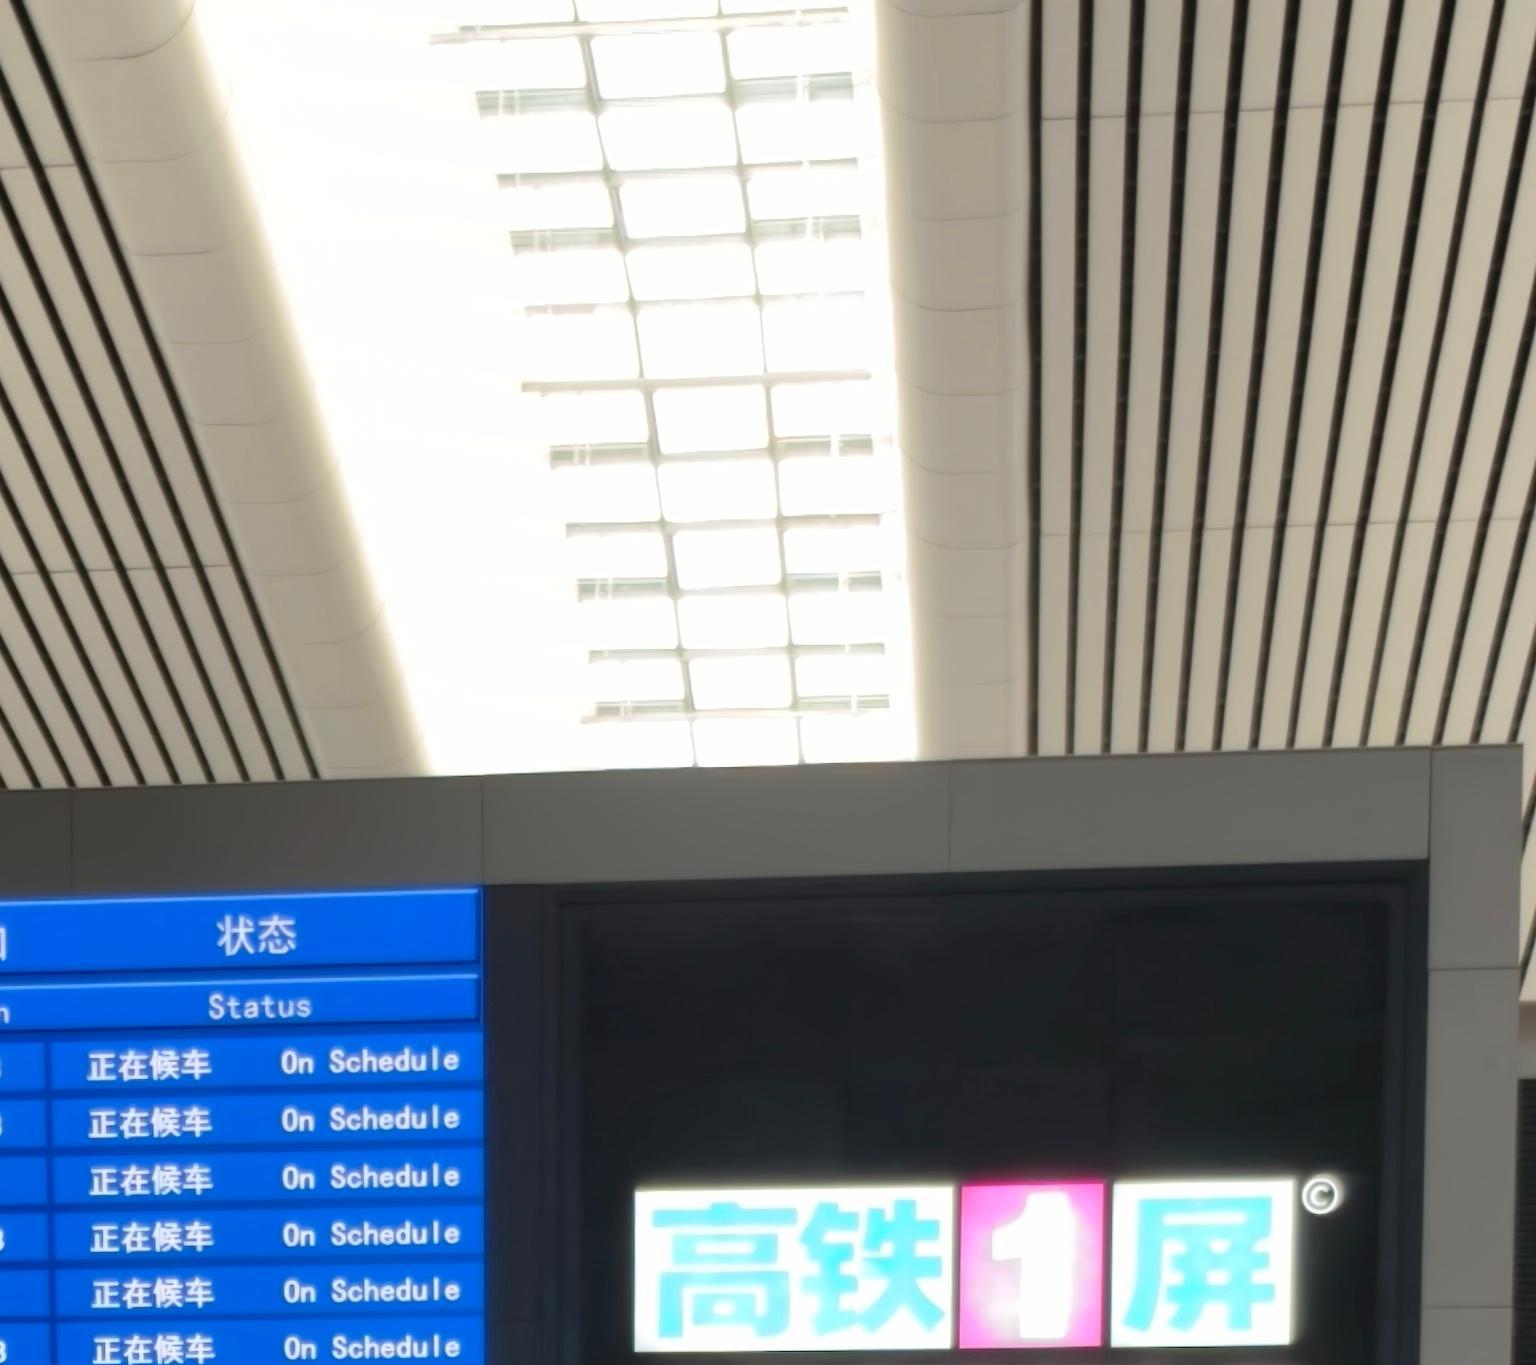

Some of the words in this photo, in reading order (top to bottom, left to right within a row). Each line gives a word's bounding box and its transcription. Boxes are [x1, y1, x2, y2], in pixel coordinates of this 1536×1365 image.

[218, 915, 295, 955] 状态
[209, 993, 311, 1019] Status
[88, 1049, 211, 1081] 正在候车
[281, 1050, 313, 1074] On
[330, 1048, 459, 1073] Schedule
[89, 1106, 211, 1138] 正在候车
[282, 1108, 314, 1131] On
[330, 1105, 459, 1130] Schedule
[90, 1164, 212, 1195] 正在候车
[283, 1166, 314, 1189] On
[331, 1163, 459, 1188] Schedule
[91, 1221, 213, 1252] 正在候车
[283, 1223, 315, 1246] On
[331, 1221, 459, 1245] Schedule
[651, 1191, 1277, 1340] 高铁1屏
[92, 1277, 214, 1308] 正在候车
[284, 1279, 315, 1303] On
[332, 1278, 460, 1302] Schedule
[93, 1334, 214, 1365] 正在候车
[285, 1336, 316, 1359] On
[333, 1335, 460, 1359] Schedule
